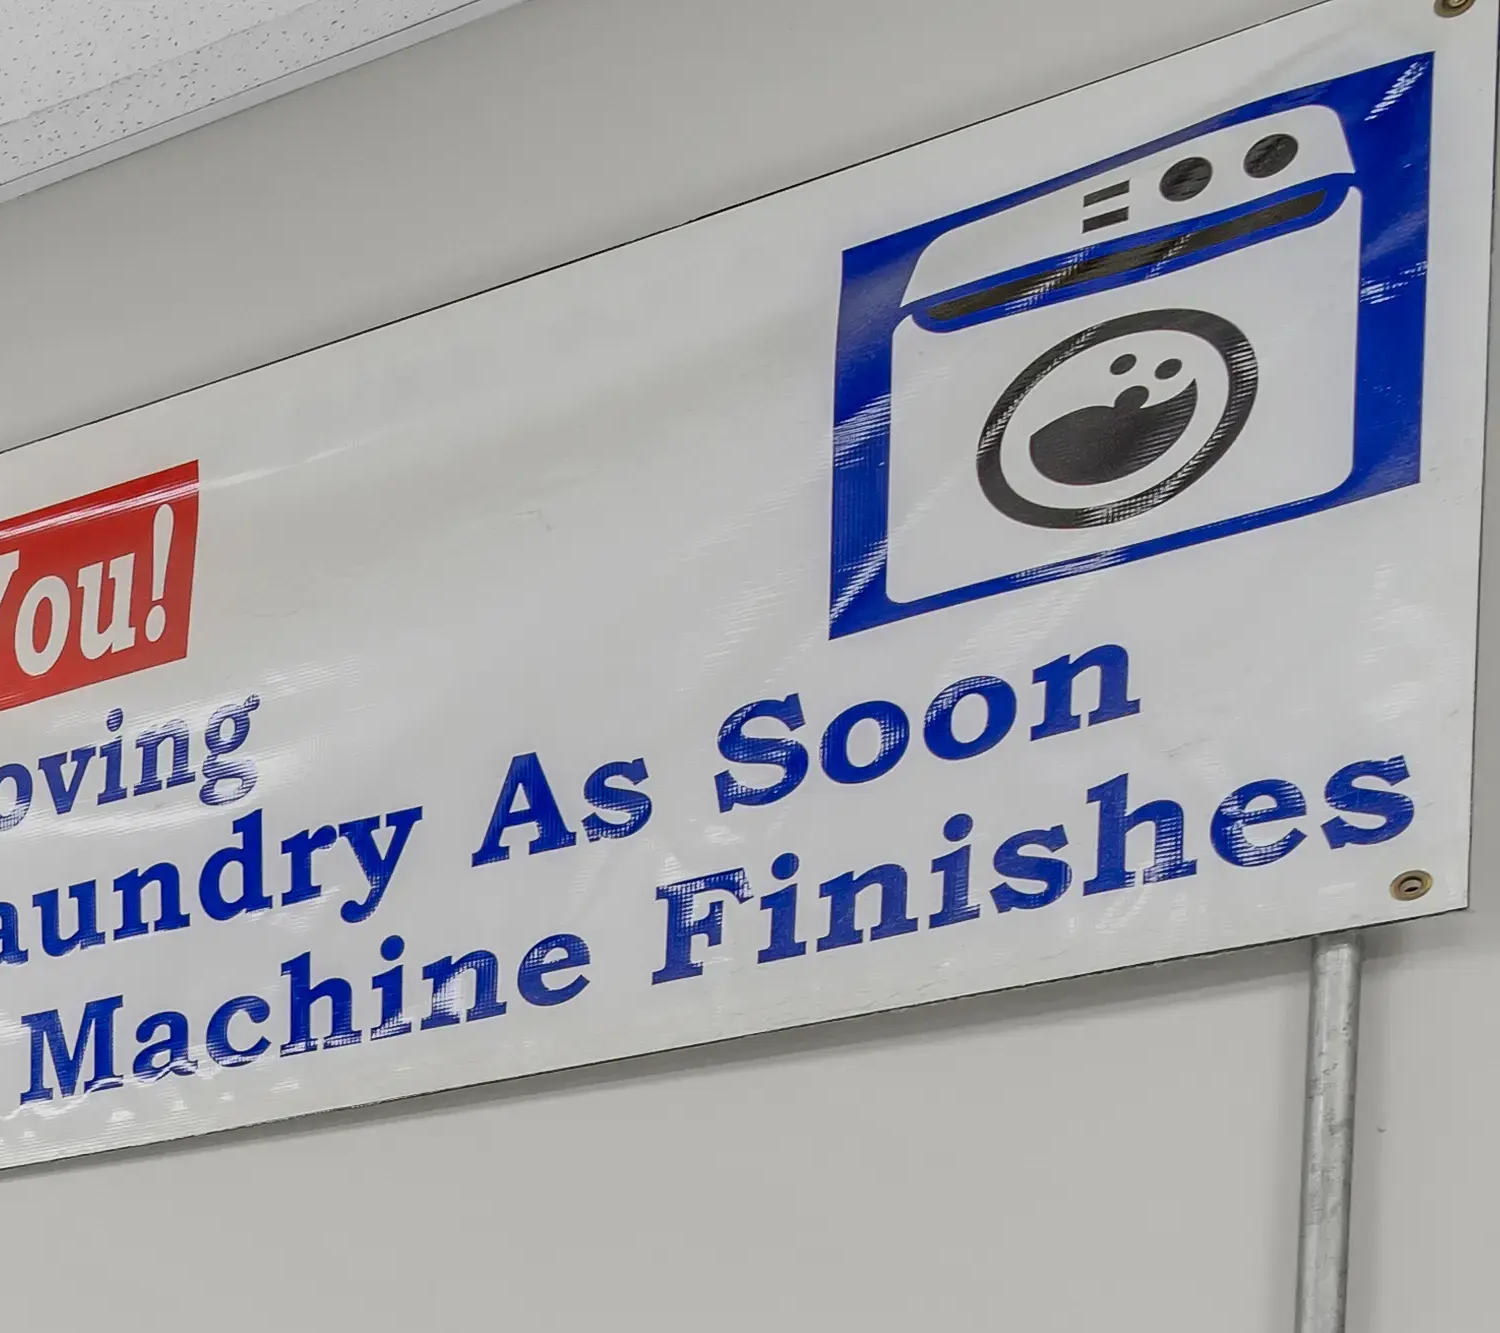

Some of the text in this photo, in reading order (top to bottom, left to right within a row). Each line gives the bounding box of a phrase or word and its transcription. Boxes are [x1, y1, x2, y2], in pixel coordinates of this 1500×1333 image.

[472, 750, 653, 867] As
[716, 641, 1142, 812] Soon
[19, 934, 594, 1100] Machine
[653, 753, 1416, 984] Finishes
